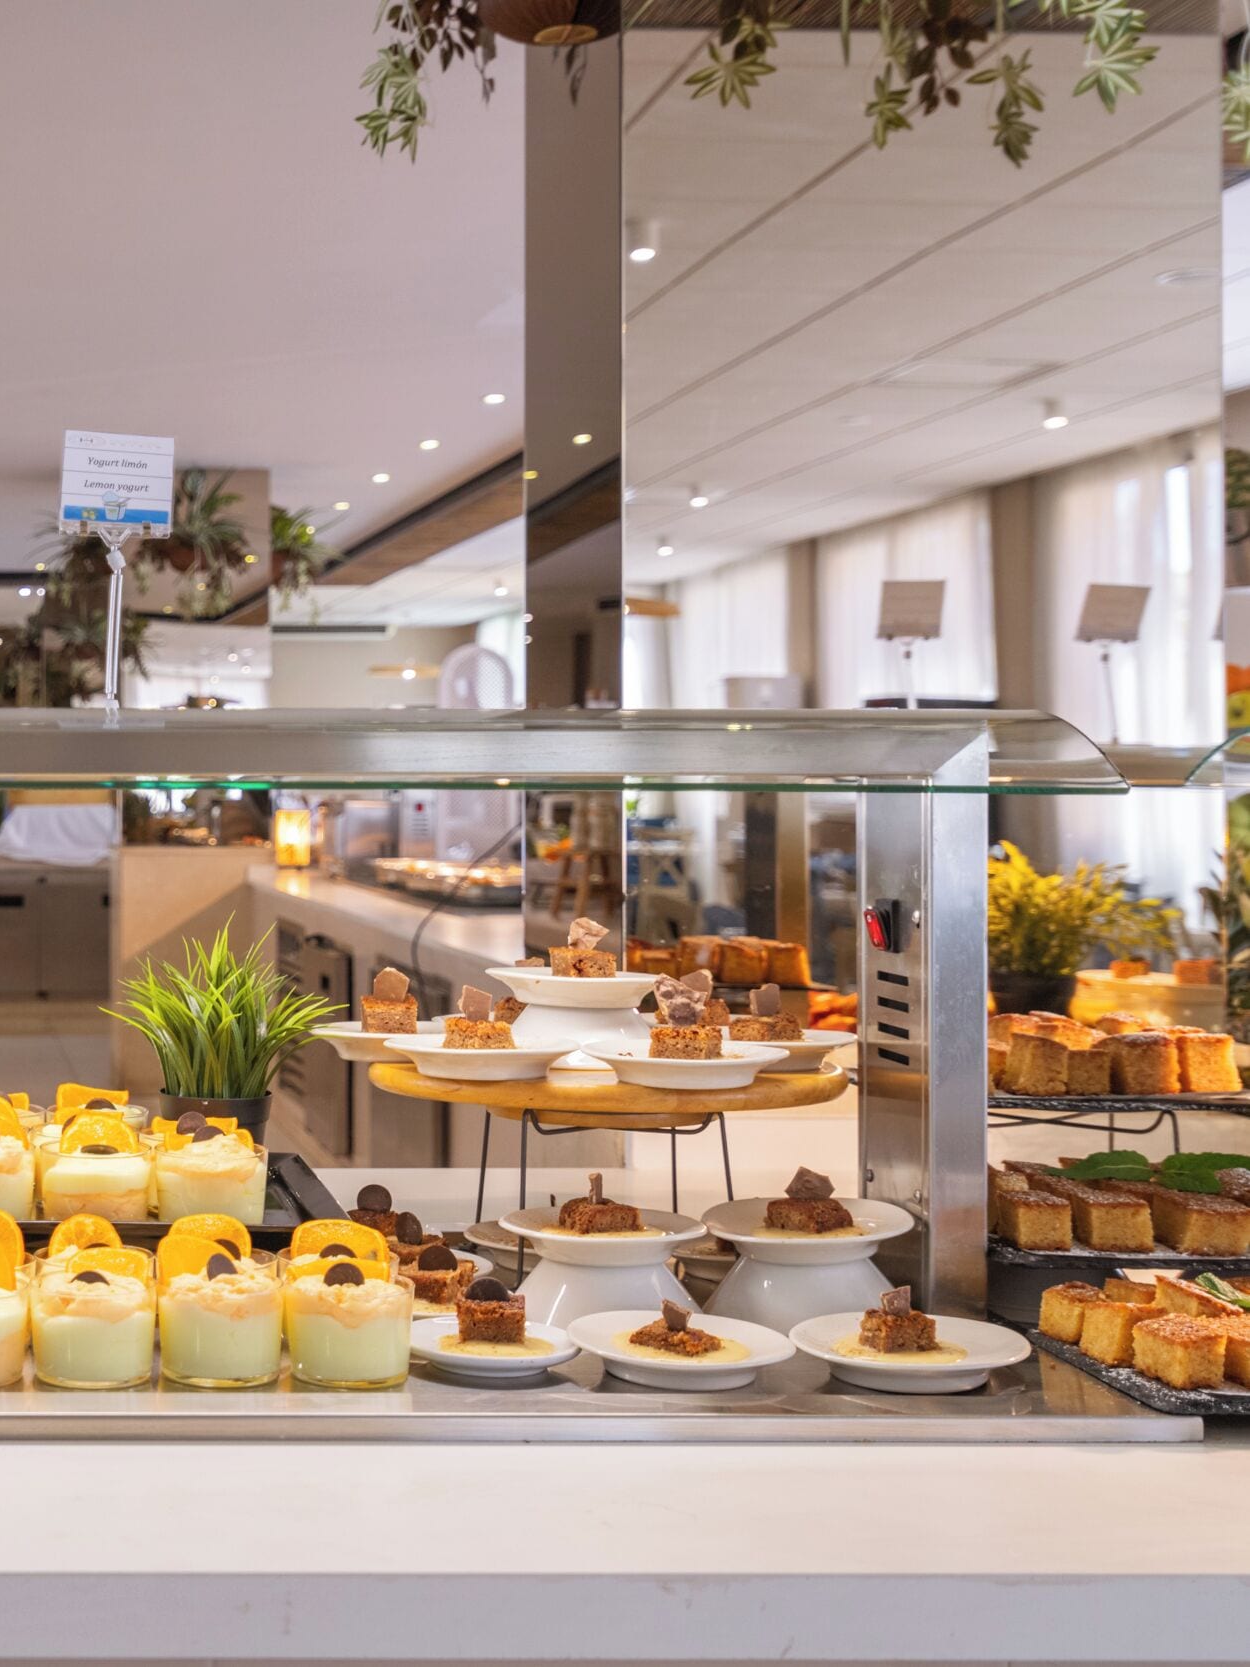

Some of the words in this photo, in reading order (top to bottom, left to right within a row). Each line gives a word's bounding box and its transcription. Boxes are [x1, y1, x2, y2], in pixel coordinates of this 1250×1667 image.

[88, 456, 119, 469] Yogurt
[84, 479, 115, 490] Lemon
[116, 483, 150, 494] yogurt
